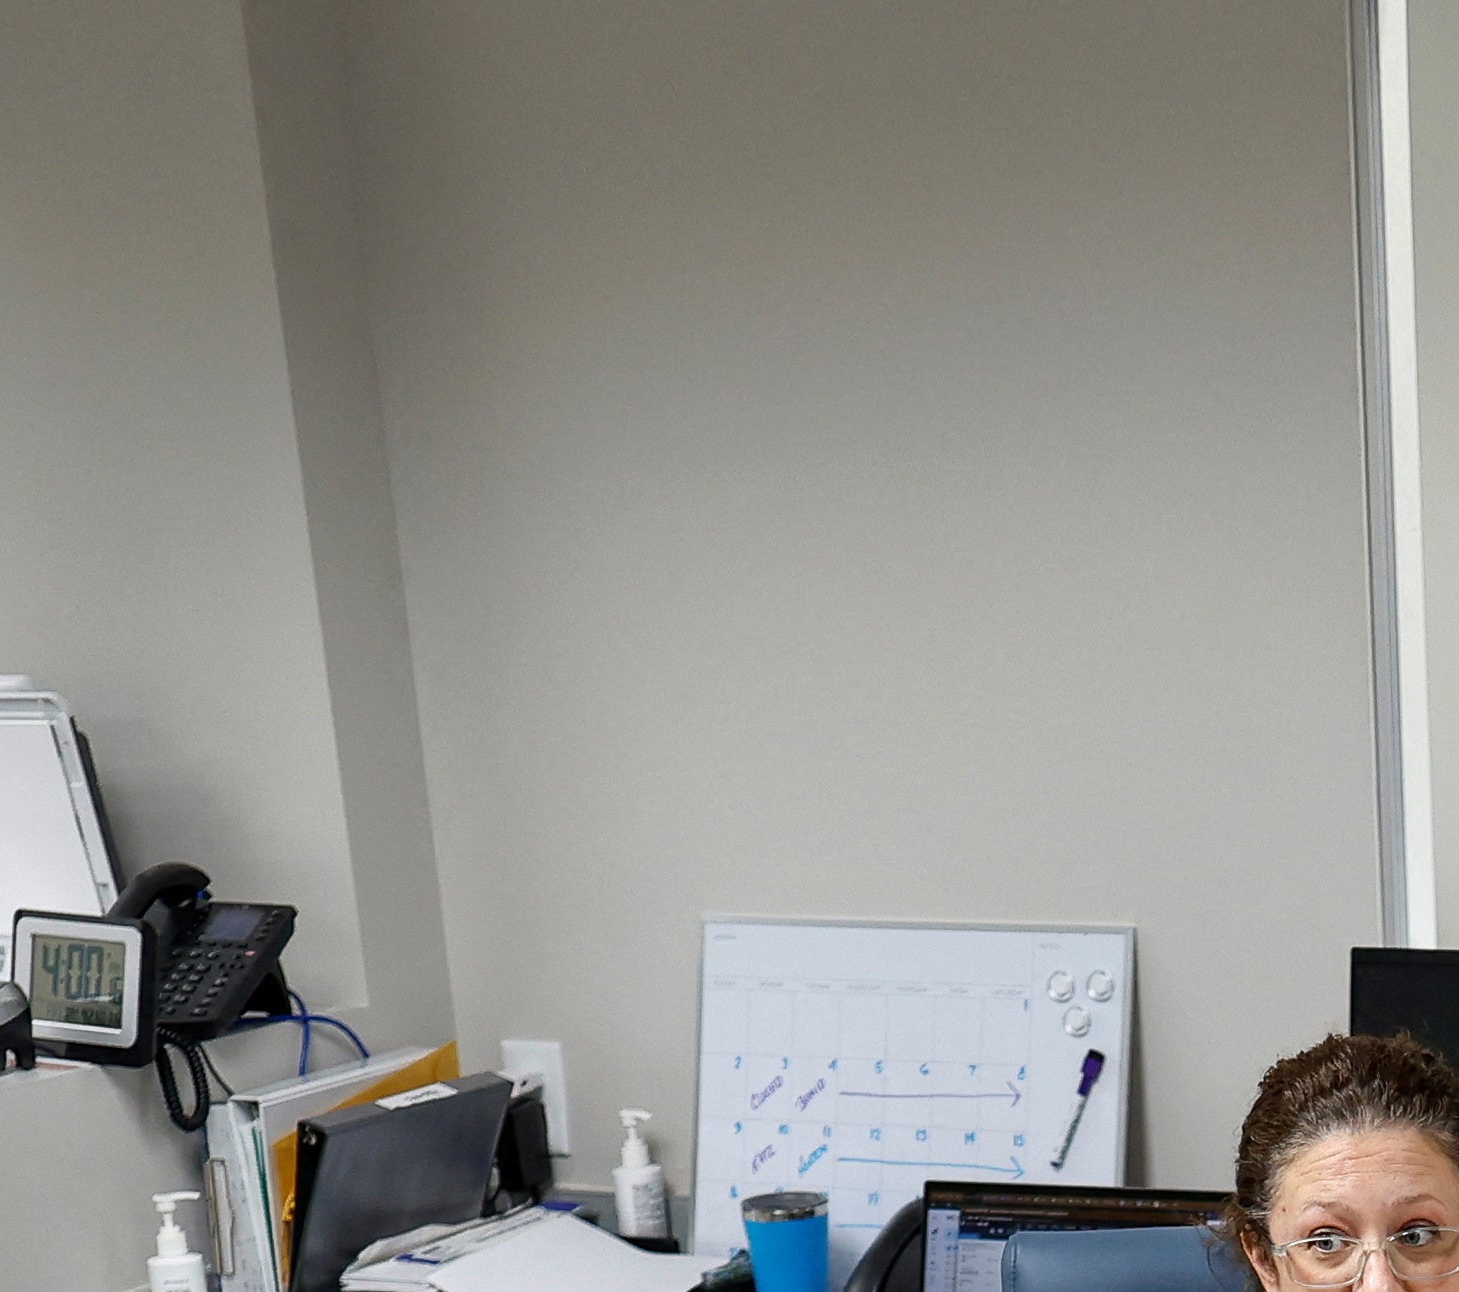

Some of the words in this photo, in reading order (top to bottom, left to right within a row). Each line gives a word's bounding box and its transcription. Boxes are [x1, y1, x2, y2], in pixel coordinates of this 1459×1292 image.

[42, 942, 104, 1000] 4:00
[734, 1056, 742, 1070] 2
[781, 1057, 789, 1070] 3
[828, 1058, 838, 1071] 4
[875, 1060, 884, 1074] 5
[919, 1062, 930, 1076] 6
[968, 1064, 978, 1076] 7
[1017, 1065, 1027, 1080] 8
[734, 1121, 743, 1134] 9
[869, 1127, 882, 1141] 12
[915, 1128, 928, 1142] 13
[964, 1131, 977, 1146] 14
[1013, 1133, 1026, 1148] 15
